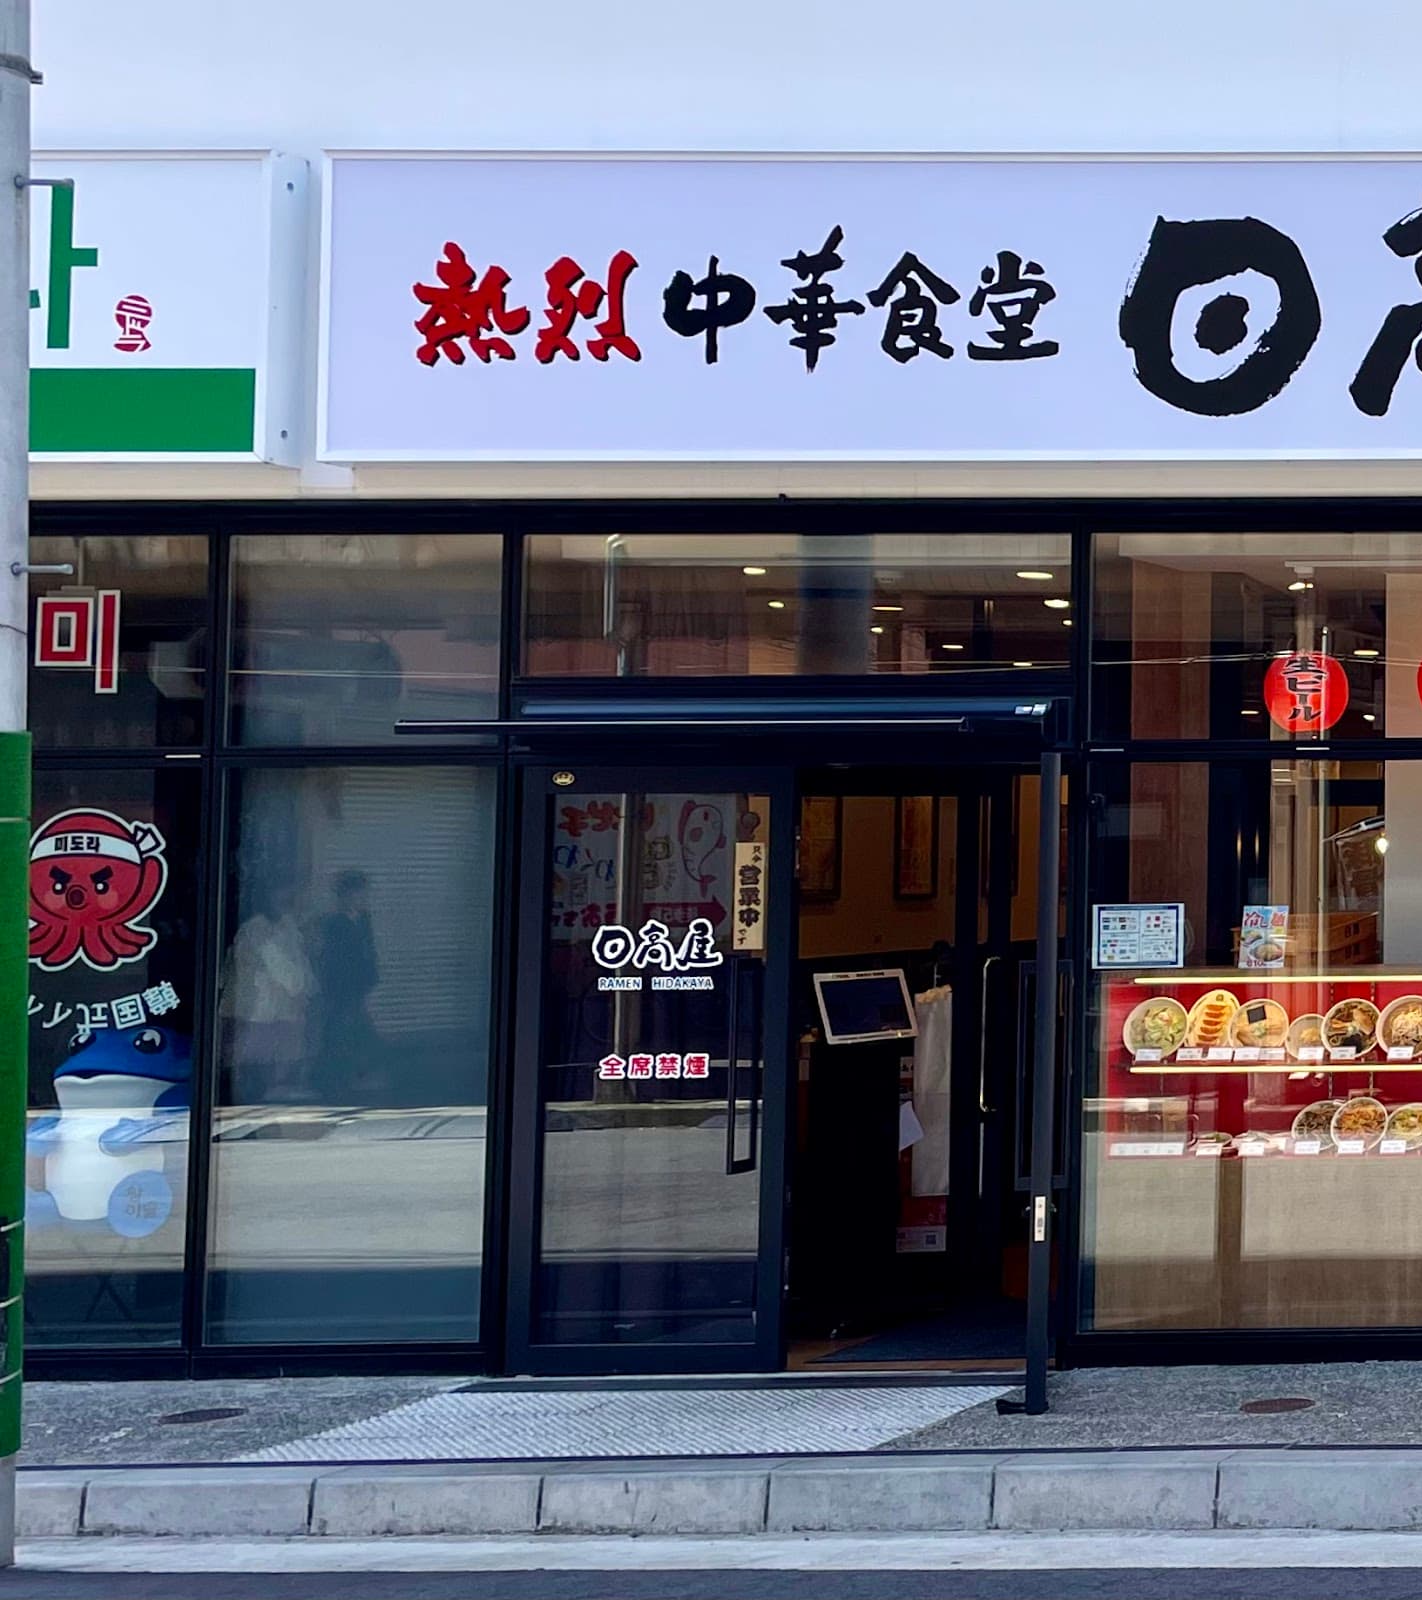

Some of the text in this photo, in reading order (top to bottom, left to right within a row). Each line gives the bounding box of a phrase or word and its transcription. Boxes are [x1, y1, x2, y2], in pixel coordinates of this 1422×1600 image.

[415, 225, 1058, 370] 熱烈 中華食堂
[1281, 654, 1327, 722] 生ビール
[54, 835, 101, 853] 미도리
[592, 919, 723, 971] 日高屋
[598, 977, 714, 990] RAMEN HIDAKAYA
[599, 1053, 710, 1080] 全席禁煙
